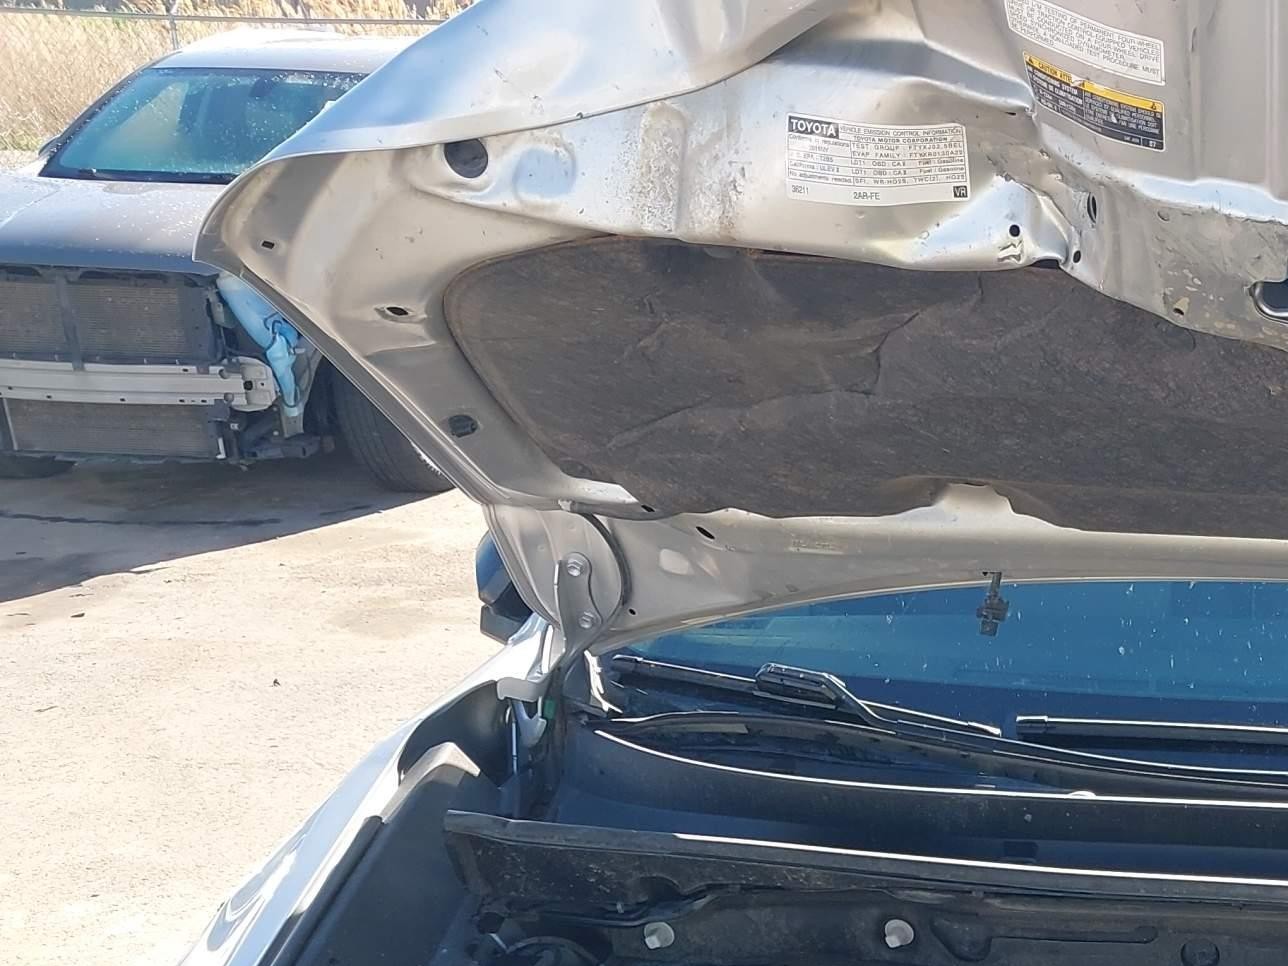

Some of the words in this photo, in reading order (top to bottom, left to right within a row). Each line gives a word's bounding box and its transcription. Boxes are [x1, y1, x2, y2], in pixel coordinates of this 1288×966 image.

[790, 118, 837, 138] TOYOTA
[853, 135, 876, 143] TOYOTA
[852, 142, 869, 150] TEST
[791, 184, 809, 195] 36211
[853, 190, 880, 201] 2AR-FE
